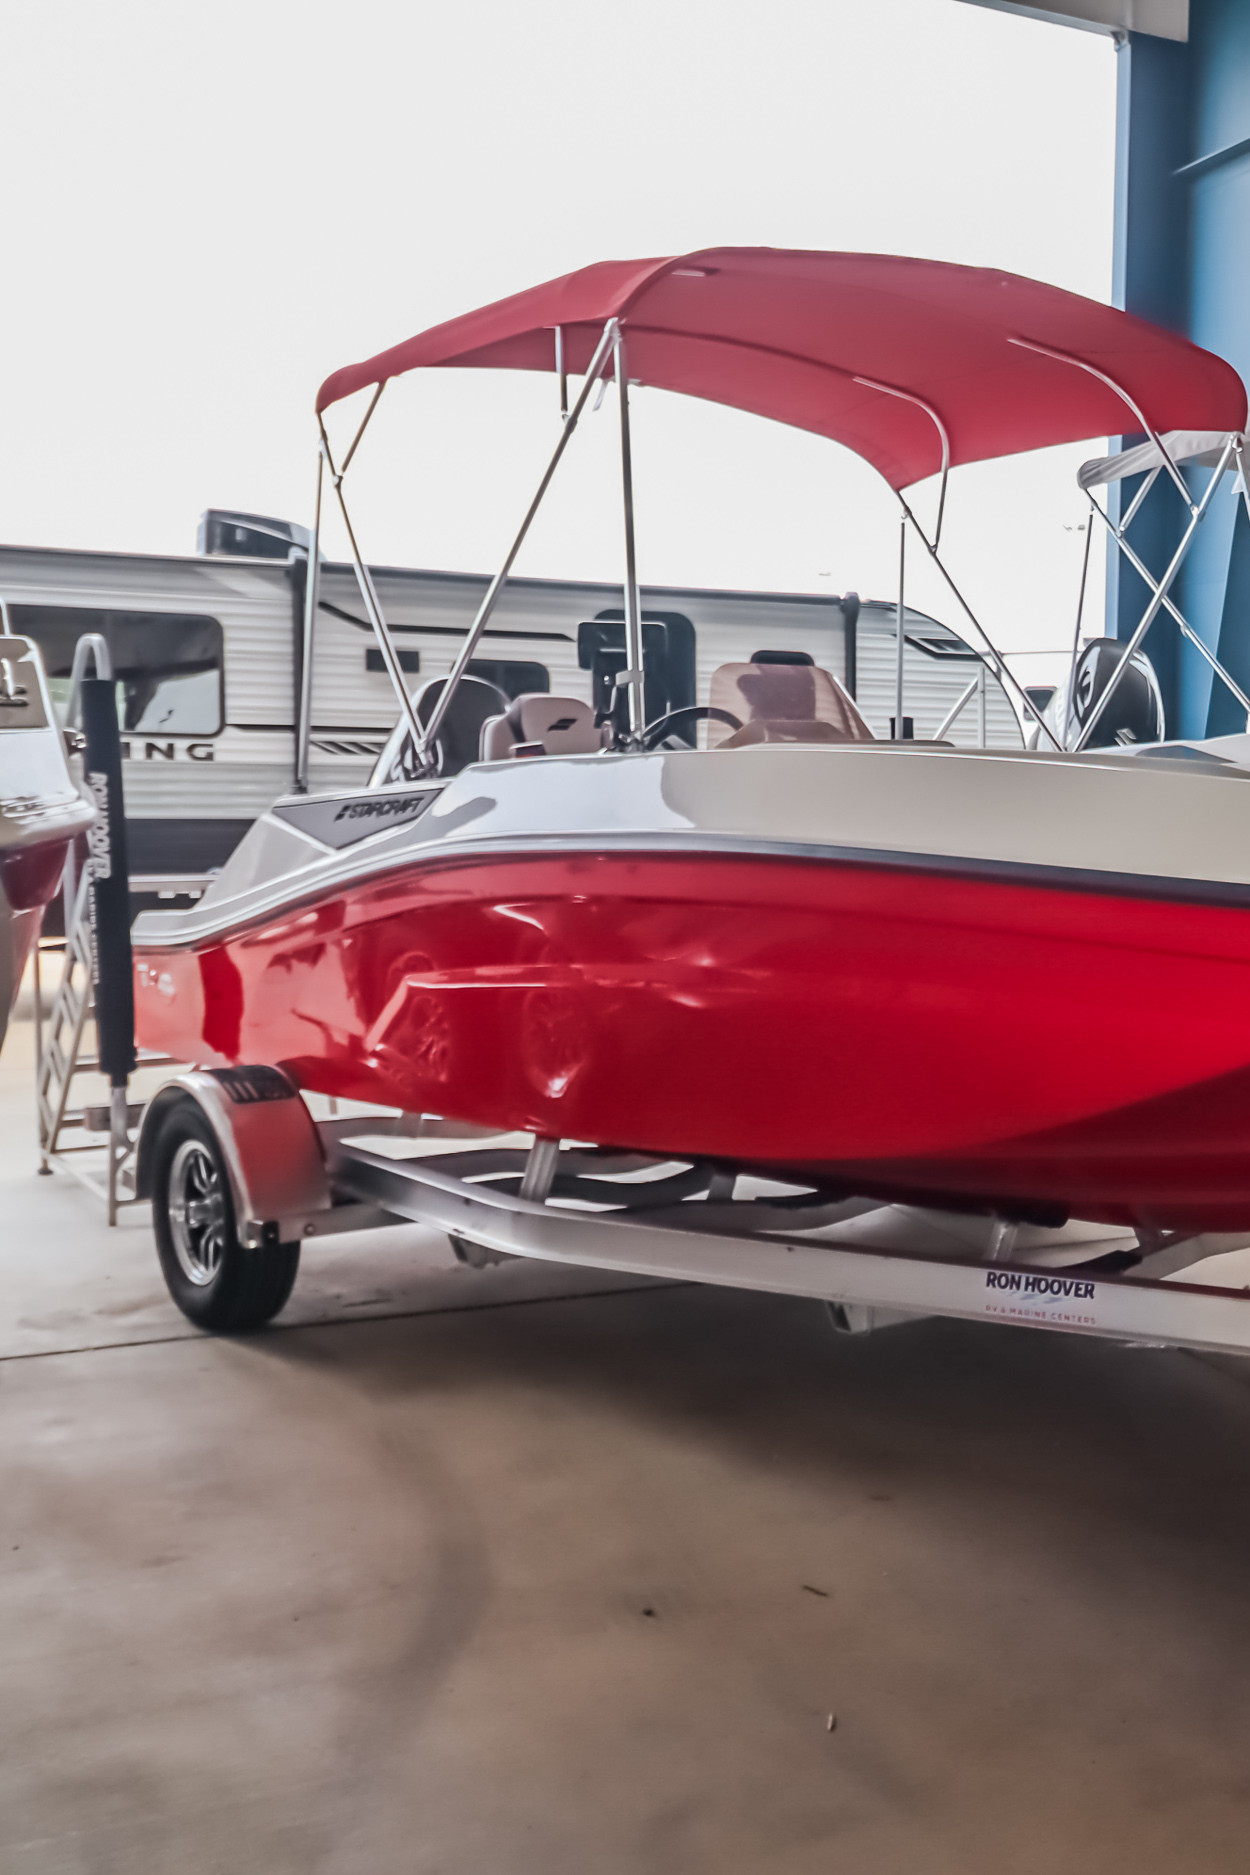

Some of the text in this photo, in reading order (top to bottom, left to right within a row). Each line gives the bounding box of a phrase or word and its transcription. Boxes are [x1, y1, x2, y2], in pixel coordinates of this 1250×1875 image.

[348, 797, 424, 819] STARCRAFT
[986, 1271, 1095, 1299] RON HOOVER
[985, 1304, 997, 1312] RV
[1009, 1307, 1046, 1319] MARINE
[1051, 1312, 1097, 1325] CENTERS
